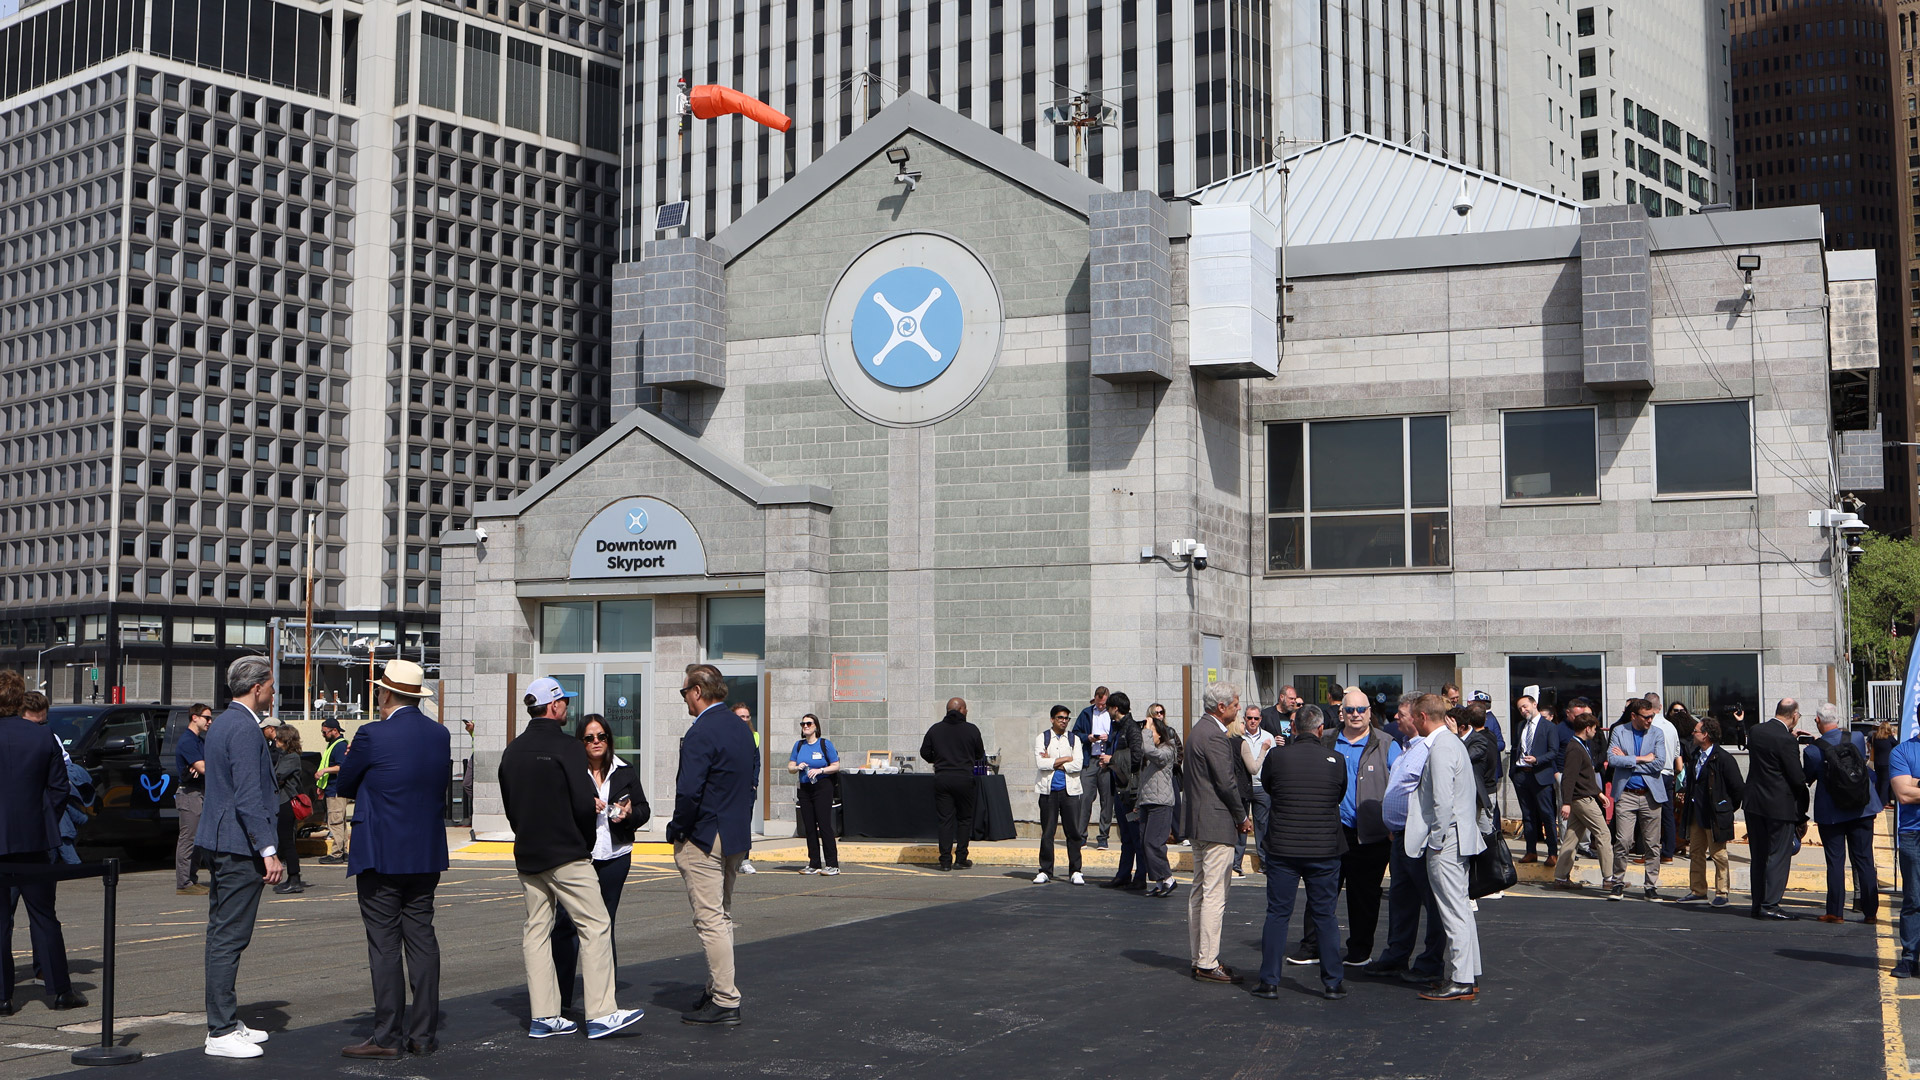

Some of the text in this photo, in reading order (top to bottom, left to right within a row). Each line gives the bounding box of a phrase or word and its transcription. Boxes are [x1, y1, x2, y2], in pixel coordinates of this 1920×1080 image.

[596, 539, 677, 553] Downtown
[607, 555, 665, 572] Skyport
[555, 1019, 564, 1029] N
[608, 1015, 620, 1023] N
